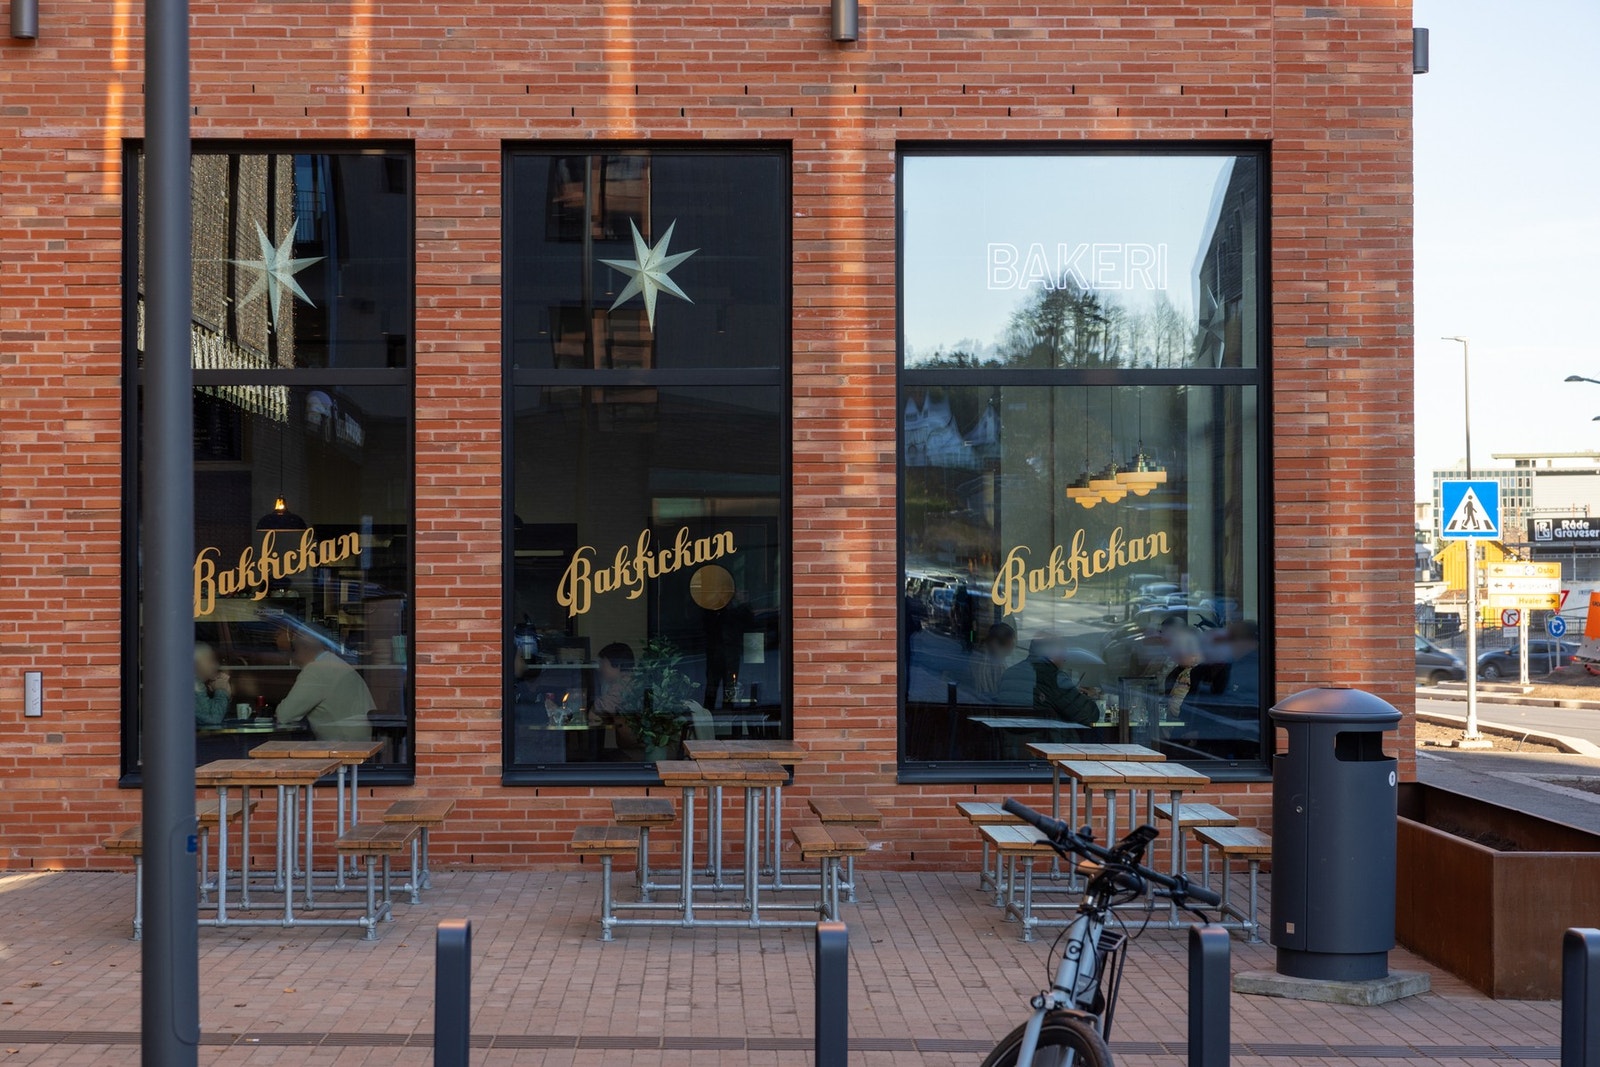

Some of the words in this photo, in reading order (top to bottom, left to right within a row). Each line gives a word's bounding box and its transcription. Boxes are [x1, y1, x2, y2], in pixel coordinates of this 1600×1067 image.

[987, 243, 1167, 290] BAKERI
[193, 527, 363, 618] Bakfickan
[556, 526, 737, 619] Bakfickan
[991, 526, 1171, 617] Bakfickan
[1537, 566, 1554, 574] Oslo
